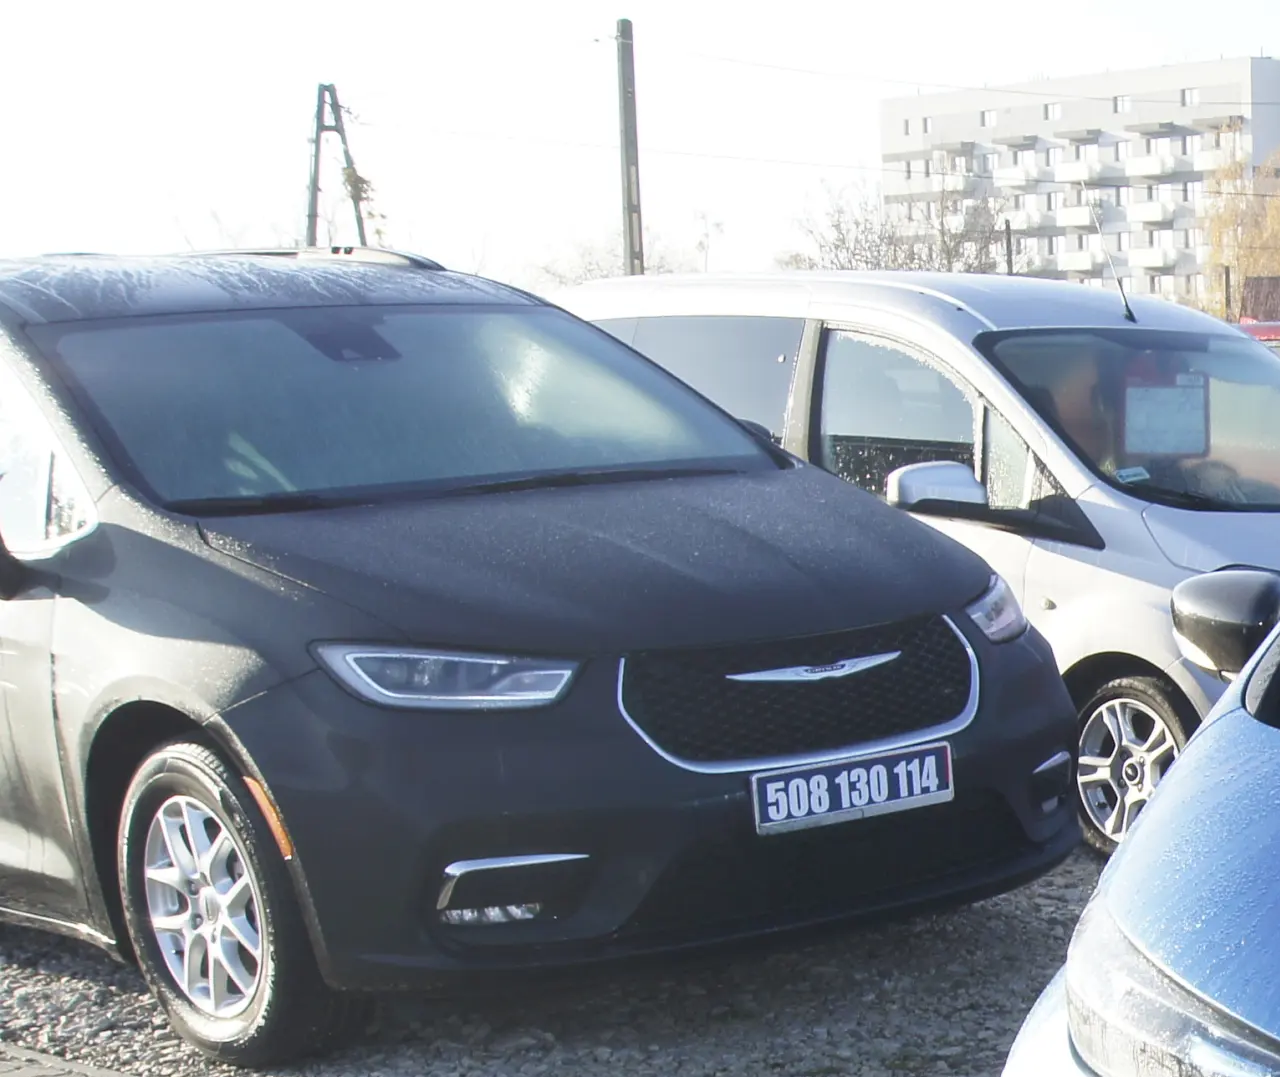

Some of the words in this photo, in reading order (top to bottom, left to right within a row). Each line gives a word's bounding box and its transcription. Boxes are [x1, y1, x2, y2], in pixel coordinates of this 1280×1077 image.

[766, 773, 830, 822] 508
[835, 763, 889, 809] 130
[893, 754, 939, 796] 114
